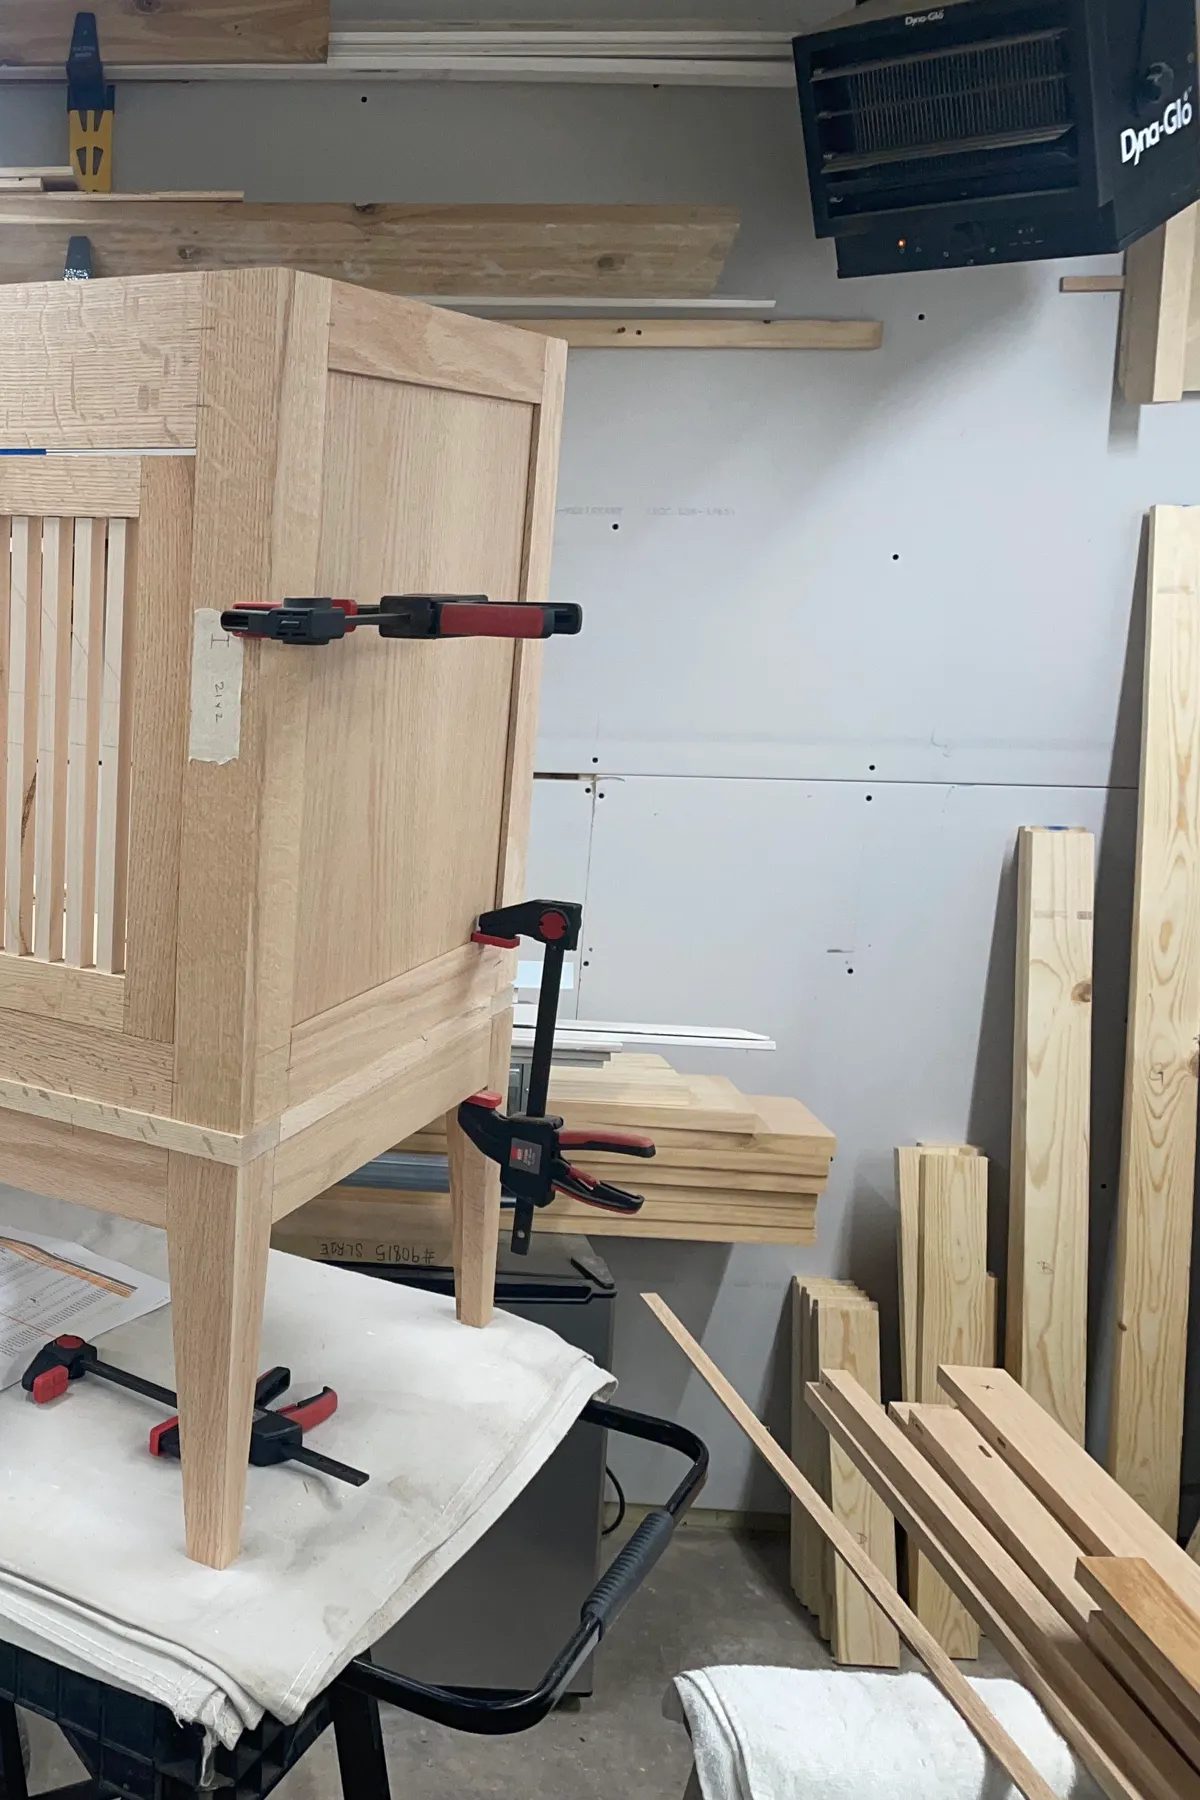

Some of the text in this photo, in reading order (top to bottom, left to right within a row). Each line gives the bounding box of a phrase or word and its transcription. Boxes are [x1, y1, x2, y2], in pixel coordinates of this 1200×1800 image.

[904, 9, 944, 27] Dyna-Glo
[1120, 95, 1192, 166] Dyna-Glo
[374, 1244, 436, 1264] #90815
